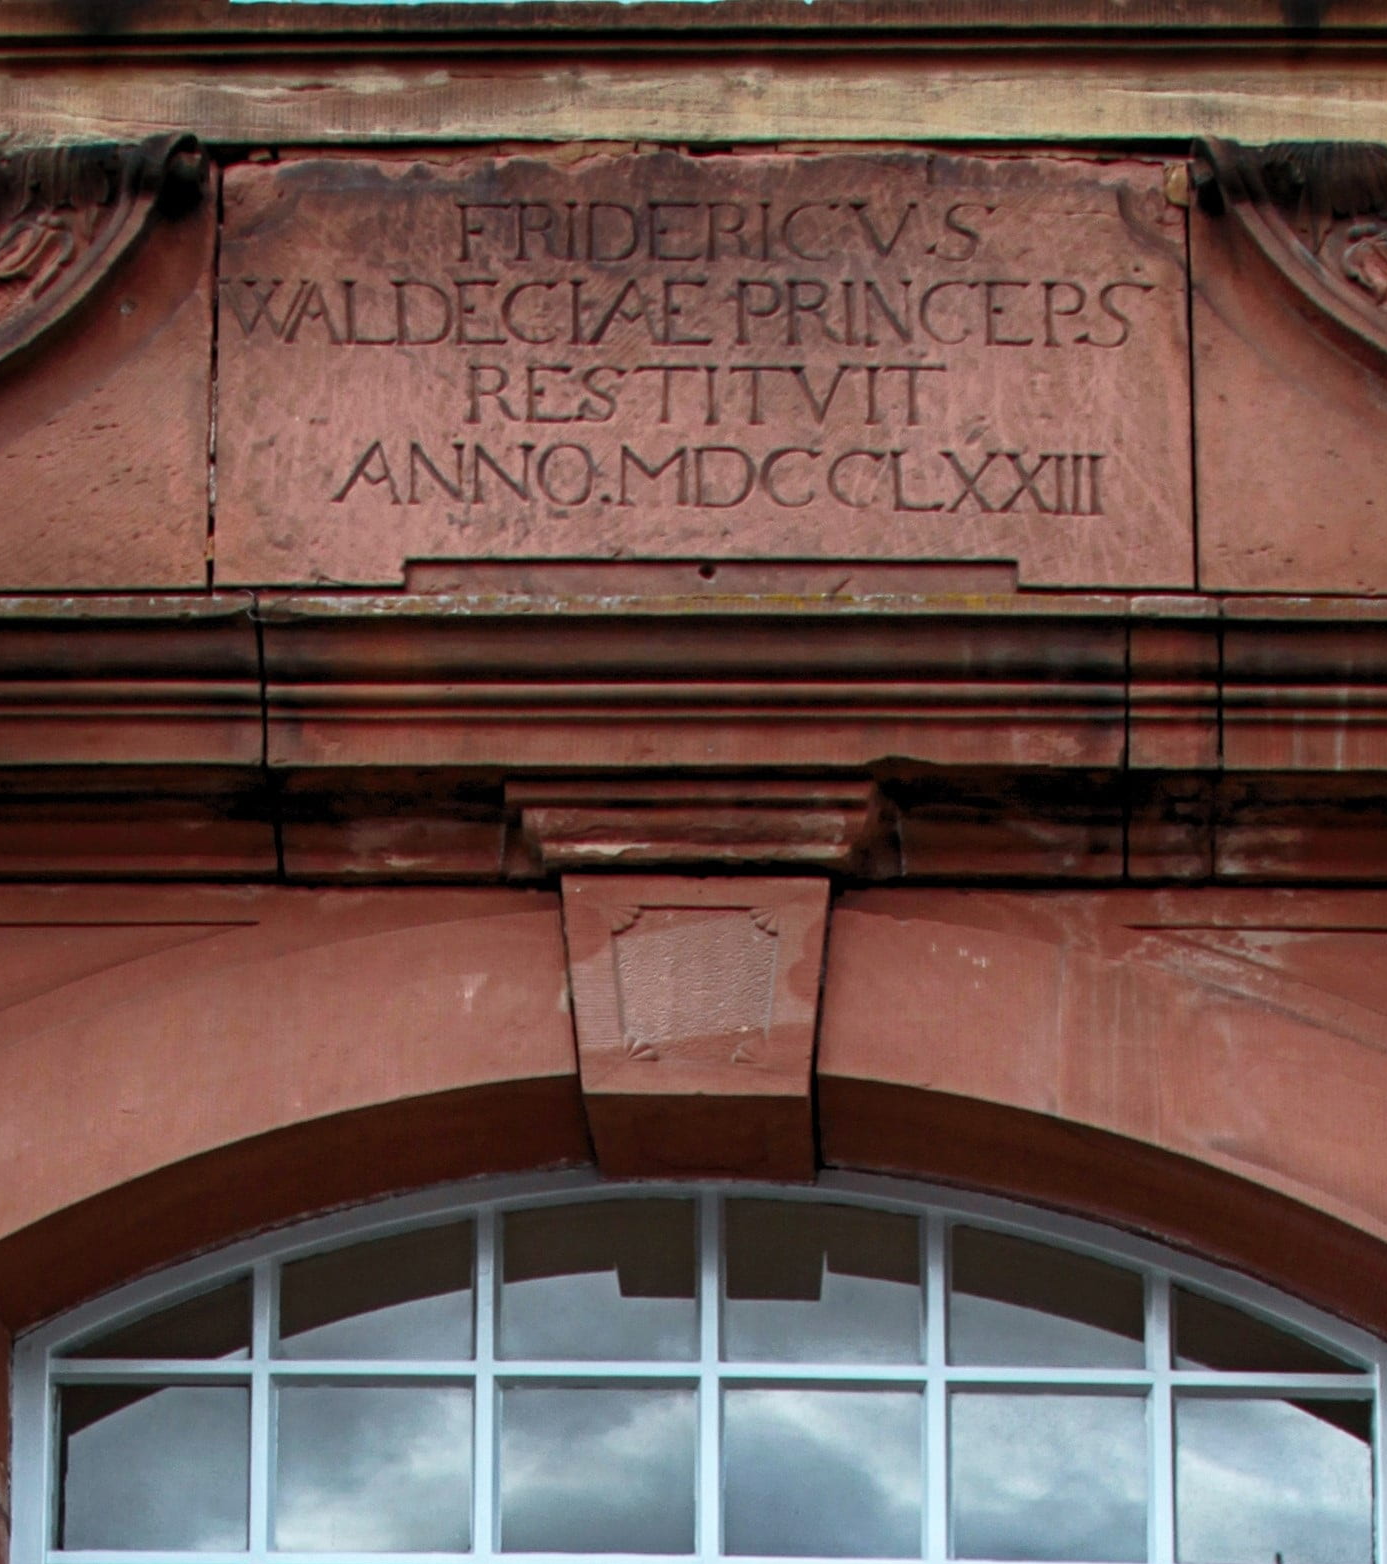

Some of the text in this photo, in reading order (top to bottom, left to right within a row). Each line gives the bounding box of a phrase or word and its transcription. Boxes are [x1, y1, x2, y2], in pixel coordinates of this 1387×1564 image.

[215, 276, 1155, 348] WALDECIAE PRINCEPS
[464, 363, 947, 426] RESTITVIT
